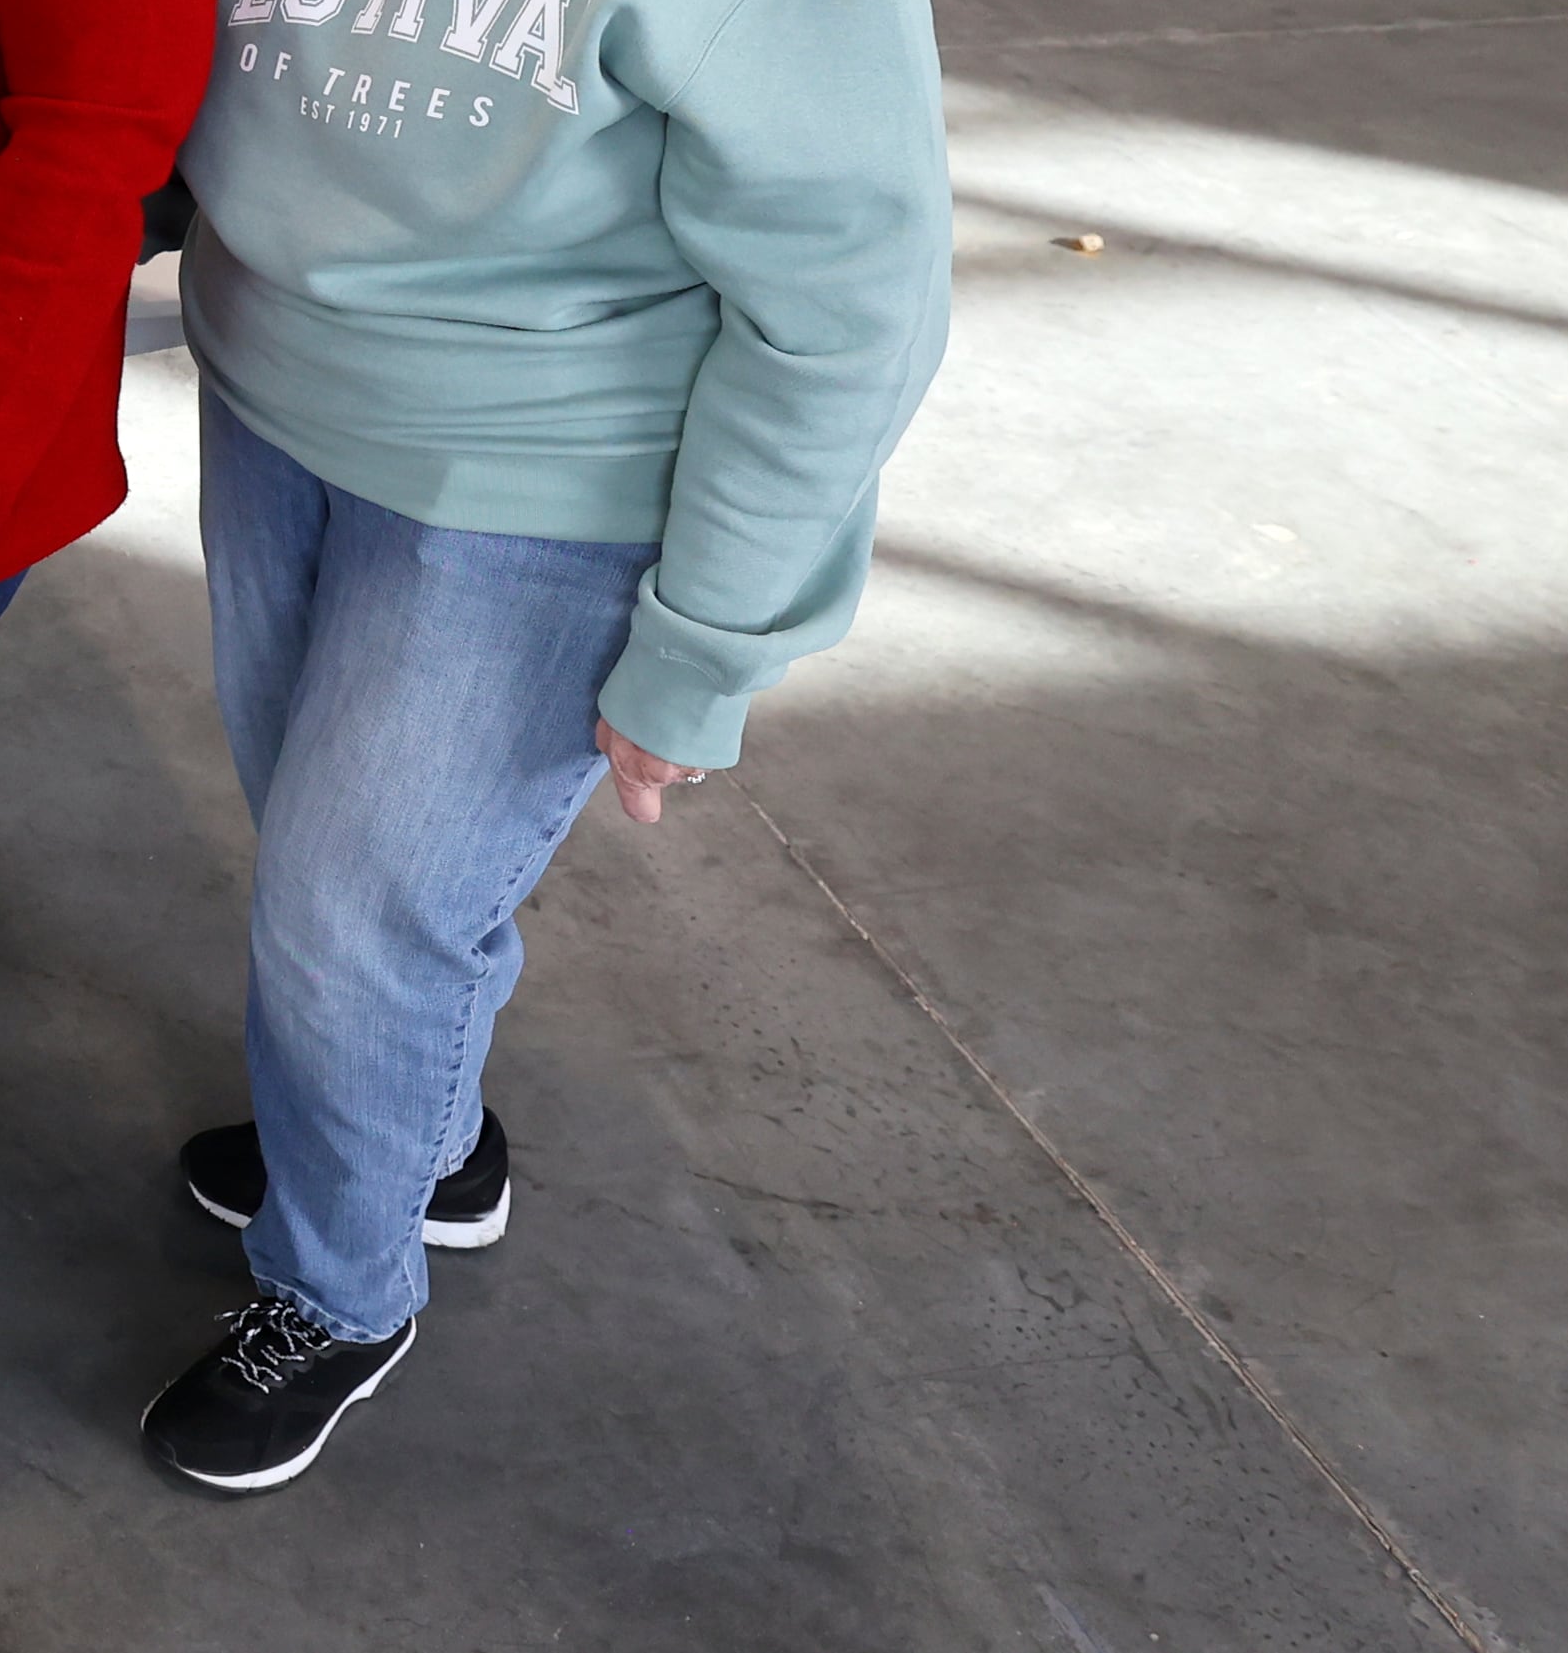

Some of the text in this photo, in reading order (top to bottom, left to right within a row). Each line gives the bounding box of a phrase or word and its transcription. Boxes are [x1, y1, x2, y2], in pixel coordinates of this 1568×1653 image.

[239, 43, 495, 128] OF TREES
[300, 95, 405, 139] EST 1971
